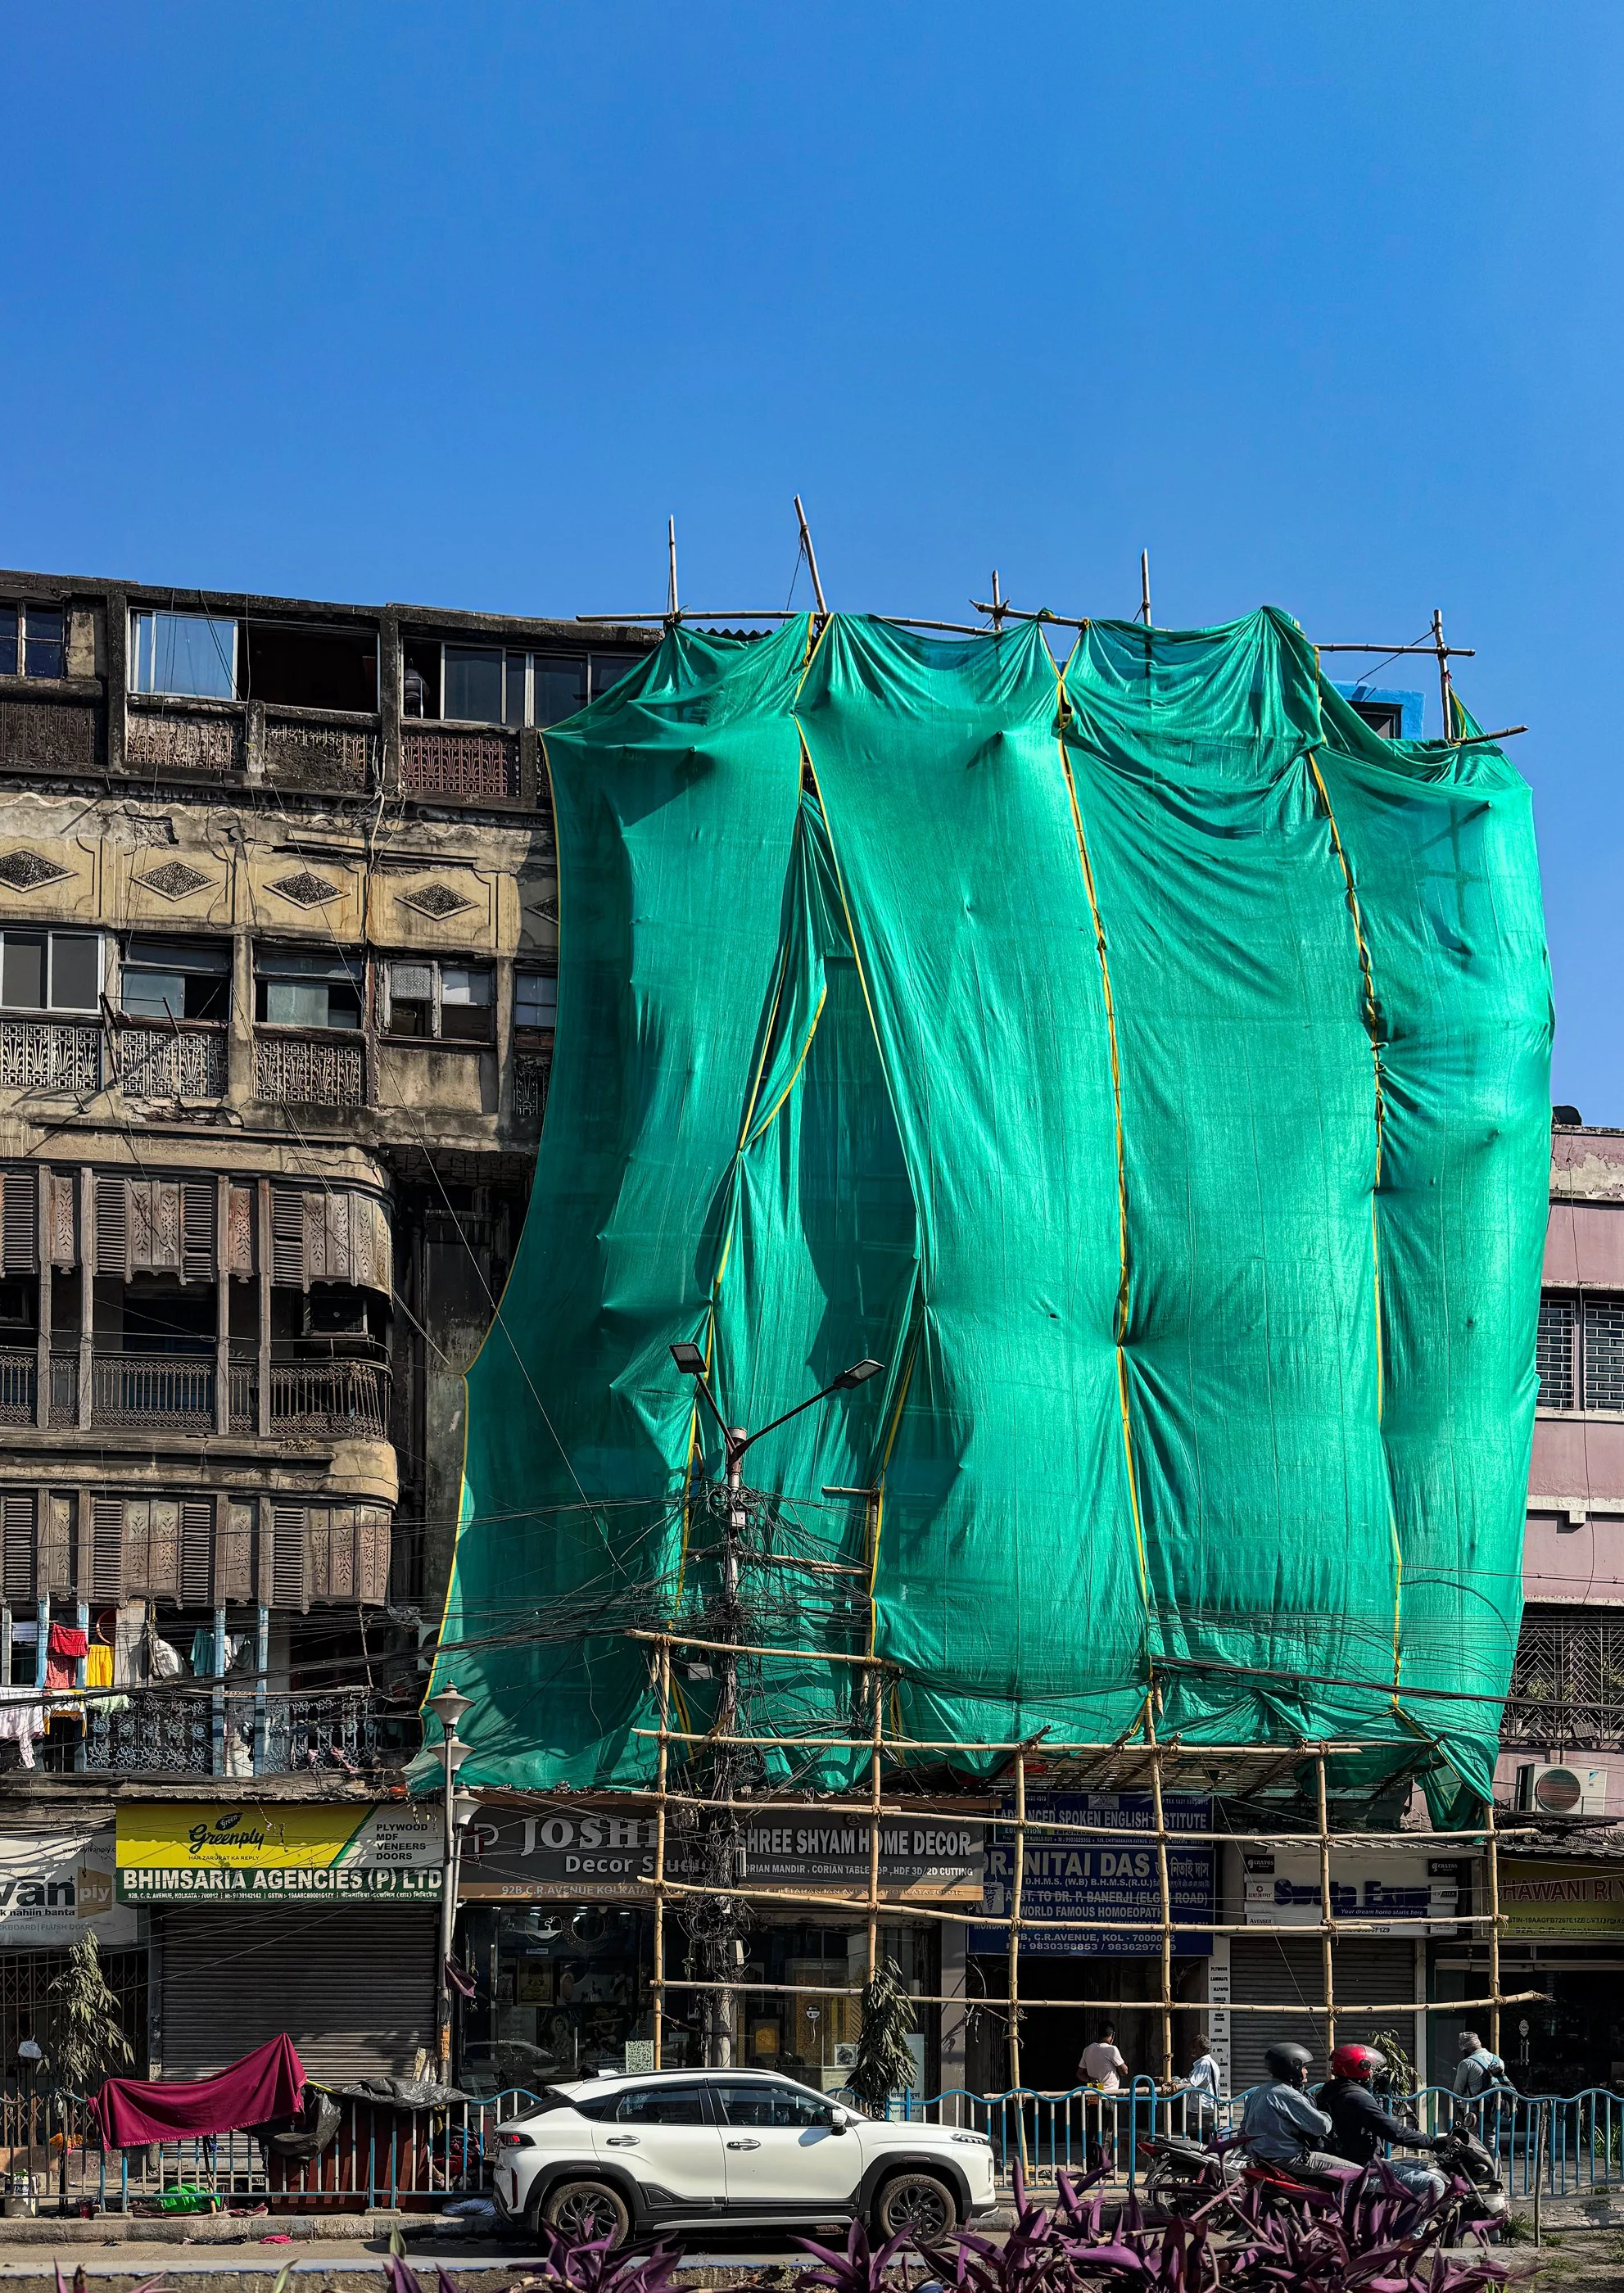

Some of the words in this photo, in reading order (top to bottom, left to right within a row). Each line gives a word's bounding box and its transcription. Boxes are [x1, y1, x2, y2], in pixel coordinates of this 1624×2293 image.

[219, 1814, 238, 1829] Green
[1001, 1809, 1055, 1823] ADNCED
[1059, 1810, 1101, 1826] SPOKEN
[1104, 1811, 1148, 1827] ENGLISH
[1151, 1812, 1206, 1829] ISTITUTE
[188, 1824, 265, 1854] Greenply
[739, 1829, 792, 1853] SHREE
[796, 1829, 855, 1854] SHYAM
[913, 1830, 971, 1856] DECOR
[565, 1856, 633, 1873] Decor
[745, 1865, 770, 1873] ORIAN
[772, 1865, 805, 1874] MANDIR
[812, 1865, 844, 1874] CORIAN
[845, 1866, 870, 1875] TABLE
[912, 1866, 938, 1876] 3D/2D
[939, 1867, 973, 1876] CUTTING
[1024, 1852, 1092, 1875] NITAI
[1101, 1852, 1150, 1877] DAS
[124, 1870, 246, 1889] BHIMSARIA
[252, 1870, 363, 1889] AGENCIES
[369, 1868, 397, 1890] (P)
[403, 1869, 442, 1888] LTD
[1065, 1878, 1088, 1887] (W.B)
[79, 1884, 111, 1902] ply
[502, 1885, 522, 1895] 92B
[526, 1886, 594, 1895] C.R.AVENUE
[1038, 1890, 1052, 1902] TO
[1054, 1891, 1072, 1902] DR.
[1087, 1891, 1133, 1902] BANERJI
[1175, 1893, 1208, 1906] ROAD)
[1498, 1878, 1587, 1902] HAWANI
[1020, 1906, 1053, 1916] WORLD
[1056, 1906, 1096, 1917] FAMOUS
[1097, 1906, 1163, 1918] HOMOEOPATH
[1029, 1942, 1098, 1951] 9830358853
